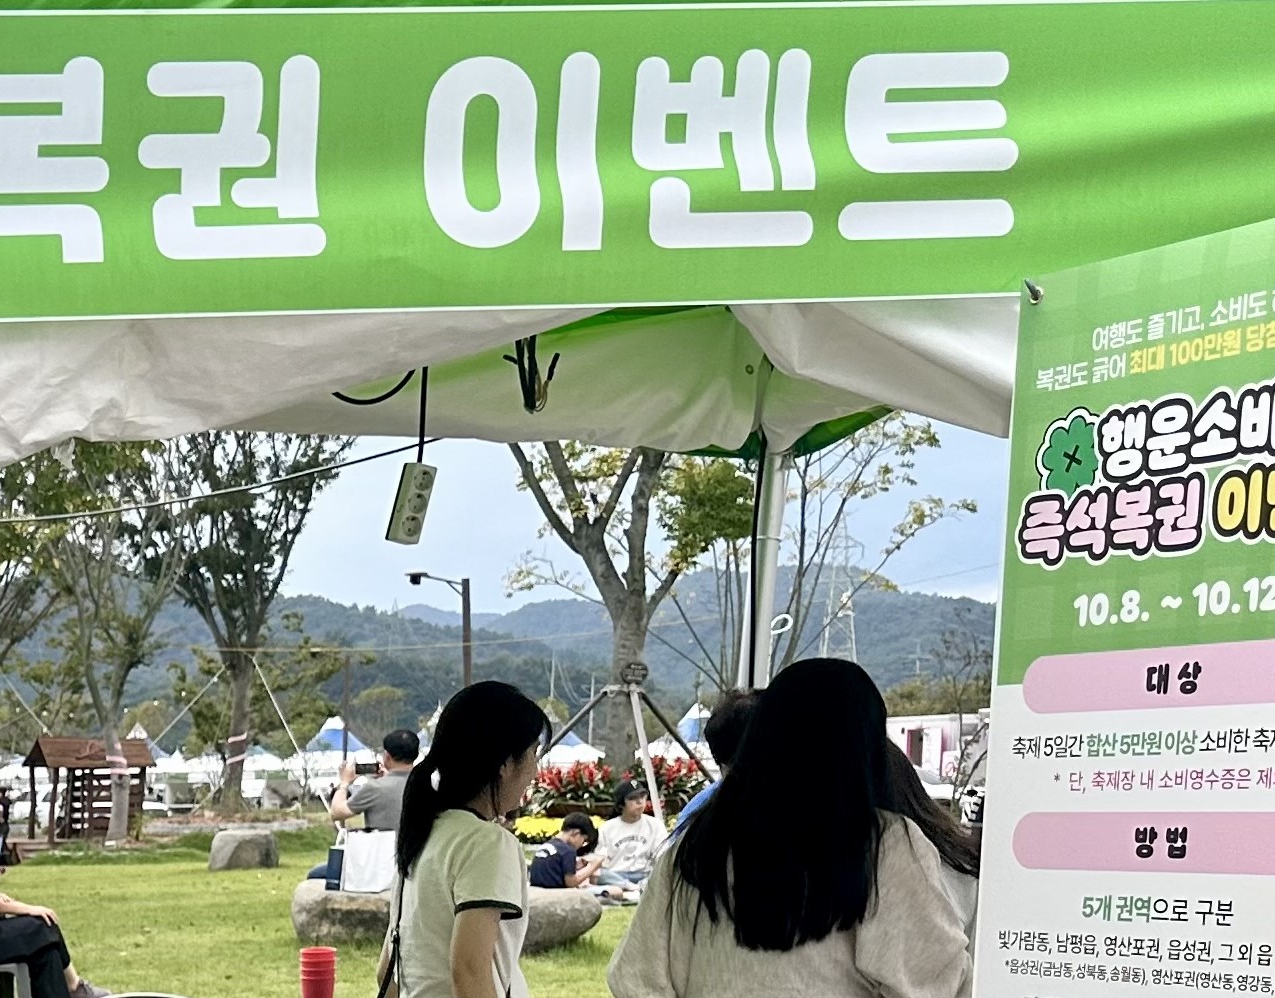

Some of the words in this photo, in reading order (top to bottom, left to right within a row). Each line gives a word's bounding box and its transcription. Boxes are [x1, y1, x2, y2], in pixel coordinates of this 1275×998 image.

[422, 47, 1019, 252] 이벤트
[1092, 318, 1143, 351] 여행도
[1147, 306, 1205, 341] 즐기고,
[1209, 291, 1267, 326] 소비도
[1036, 361, 1088, 391] 복권도
[1092, 352, 1126, 383] 긁어
[1129, 344, 1165, 374] 최대
[1169, 328, 1242, 366] 100만원
[1023, 478, 1202, 559] 즉석복권
[1073, 589, 1150, 628] 10.8.
[1012, 735, 1041, 759] 축제
[1044, 734, 1084, 758] 5일간
[1086, 732, 1118, 758] 합산
[1165, 730, 1198, 755] 이상
[1199, 728, 1250, 753] 소비한
[1068, 771, 1087, 795] 단,
[1091, 770, 1135, 791] 축제장
[1140, 769, 1154, 791] 내
[1158, 768, 1251, 790] 소비영수증은
[1256, 767, 1275, 790] 제
[1082, 896, 1112, 921] 5개
[1115, 896, 1189, 923] 권역으로
[1195, 899, 1234, 926] 구분
[999, 930, 1052, 955] 빛가람동,
[1056, 933, 1100, 958] 남평읍,
[1104, 935, 1163, 963] 영산포권,
[1167, 939, 1215, 965] 읍성권,
[1218, 943, 1234, 961] 그
[1237, 943, 1253, 965] 외
